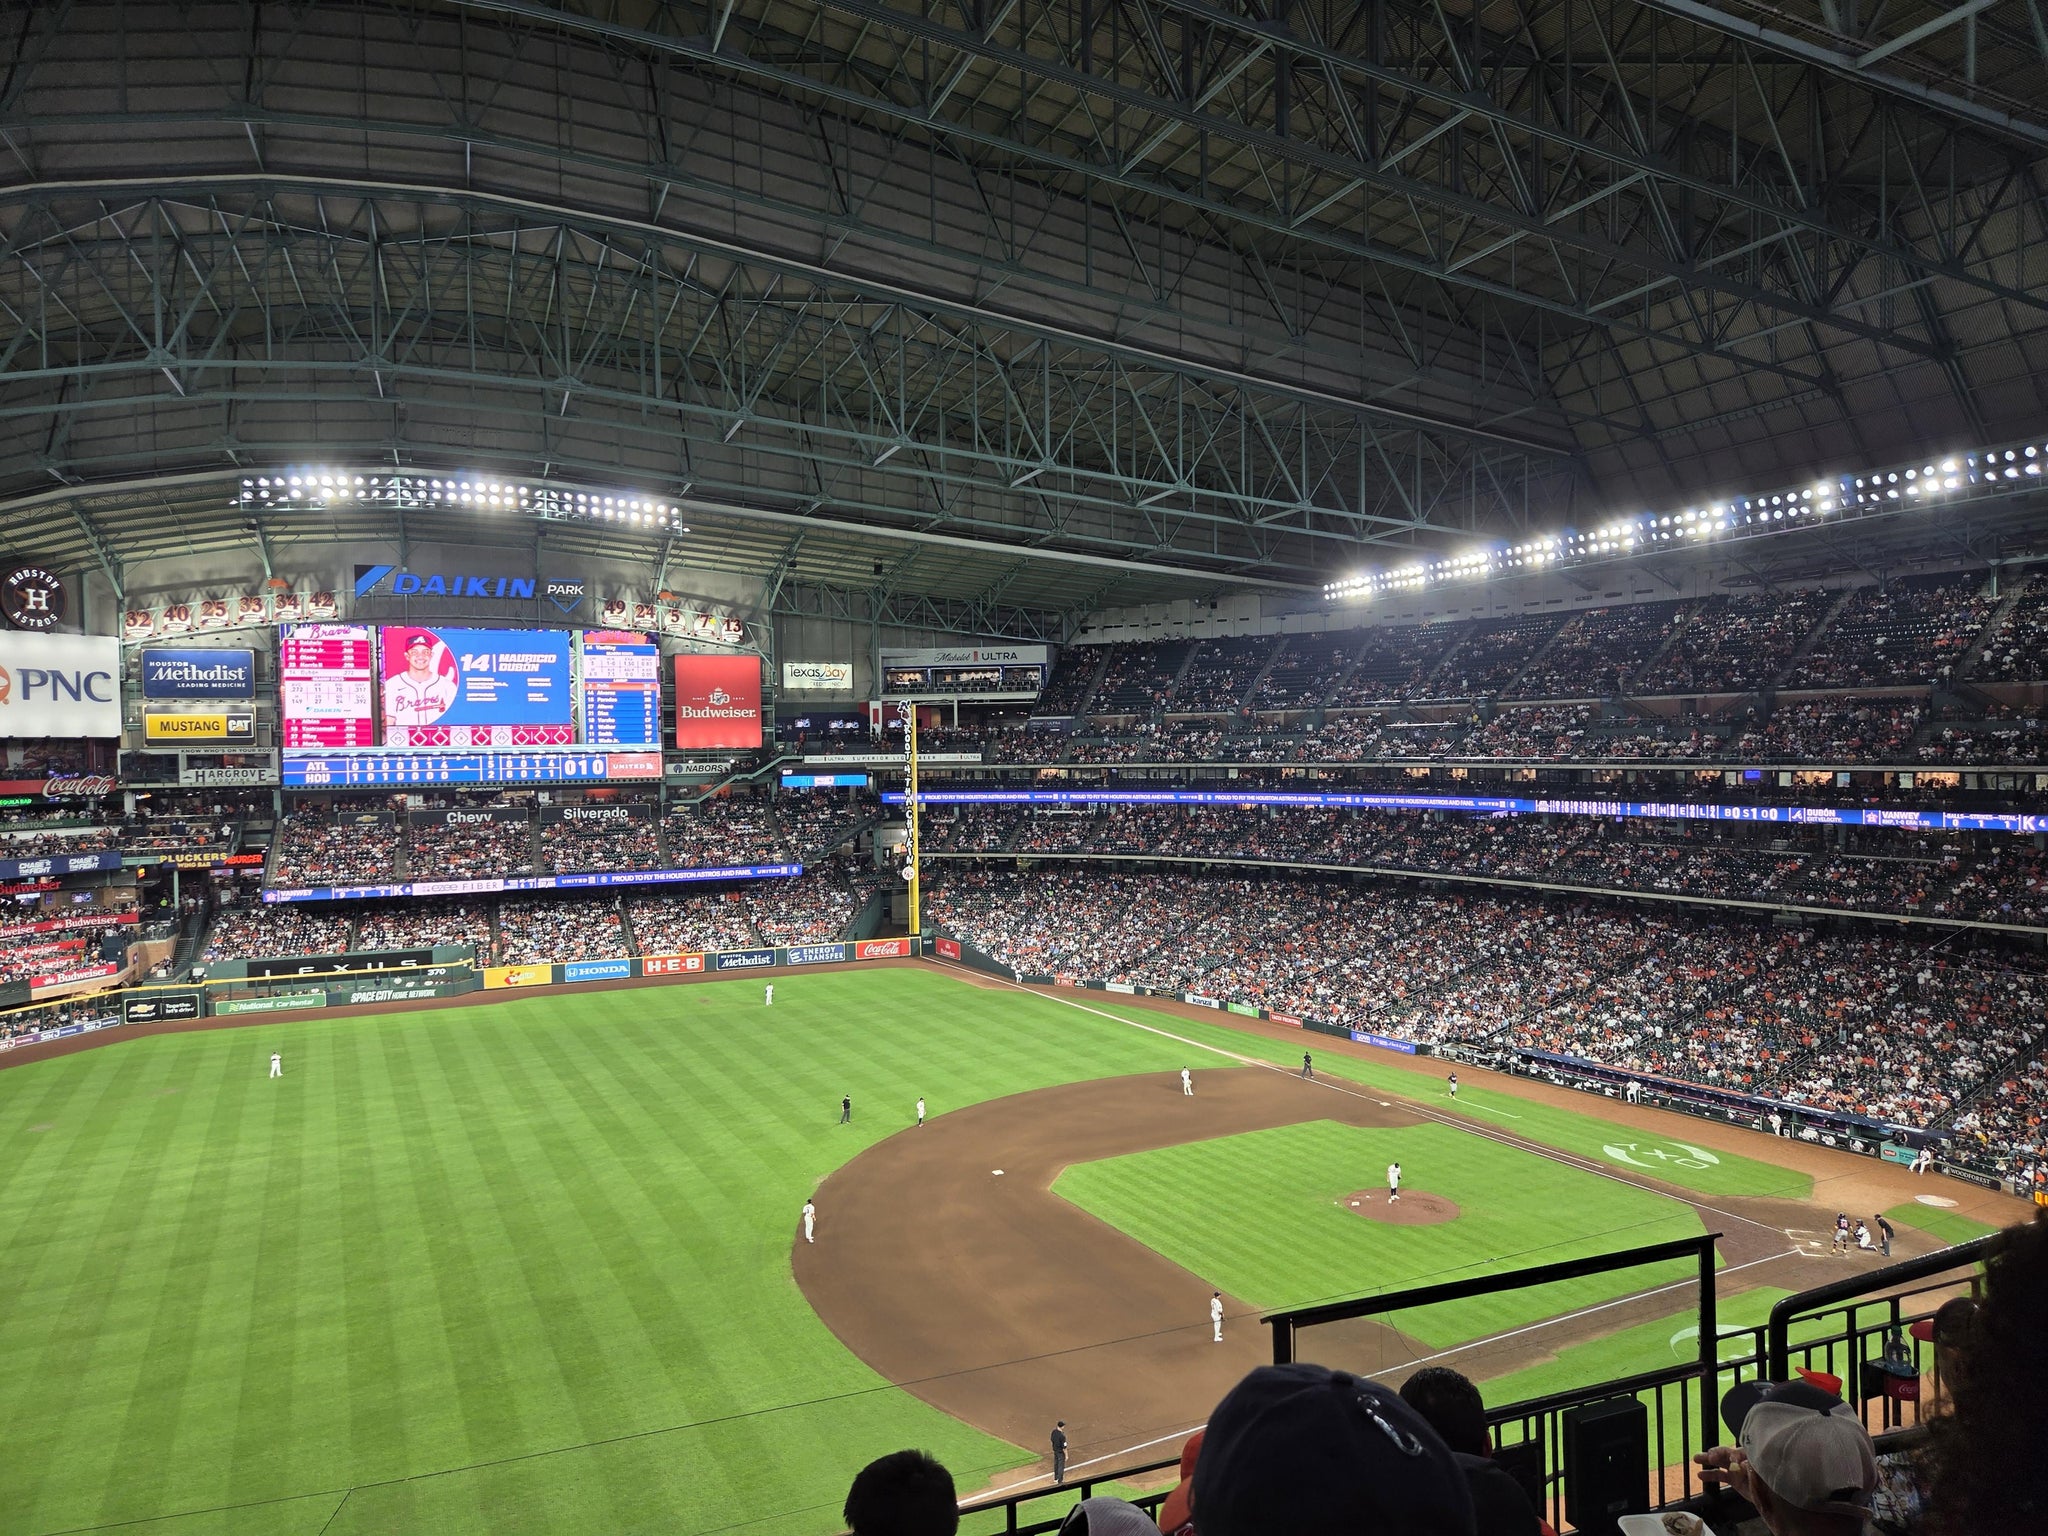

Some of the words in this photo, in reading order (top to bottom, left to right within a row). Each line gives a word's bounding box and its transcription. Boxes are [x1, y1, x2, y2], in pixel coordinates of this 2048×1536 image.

[8, 569, 60, 590] HOUSTON
[392, 573, 536, 598] DAIKIN
[547, 584, 584, 595] PARK
[24, 588, 49, 611] H
[239, 596, 264, 613] 33
[275, 594, 300, 609] 34
[310, 592, 334, 607] 42
[163, 604, 190, 622] 40
[201, 600, 227, 618] 25
[604, 600, 626, 614] 49
[635, 604, 656, 619] 24
[12, 611, 58, 627] ASTROS
[126, 610, 152, 628] 32
[670, 609, 680, 623] 5
[700, 614, 710, 628] 7
[724, 619, 742, 632] 13
[460, 653, 490, 672] 14
[498, 653, 557, 663] MAURICIO
[934, 653, 971, 662] Michelob
[981, 652, 1018, 661] ULTRA
[150, 664, 246, 681] Methodist
[788, 665, 820, 678] Texas
[825, 665, 847, 681] Bay
[16, 668, 112, 703] PNC
[160, 720, 220, 732] MUSTANG
[228, 719, 251, 732] CAT
[903, 724, 912, 761] ROOT
[306, 761, 330, 771] ATL
[352, 762, 359, 770] 0
[367, 762, 374, 770] 0
[382, 762, 389, 770] 0
[397, 762, 404, 770] 0
[426, 761, 432, 769] 1
[440, 761, 448, 769] 4
[488, 760, 495, 768] 5
[506, 760, 513, 768] 8
[520, 760, 527, 768] 0
[534, 760, 540, 768] 1
[564, 759, 576, 775] 0
[578, 759, 588, 775] 1
[592, 759, 604, 775] 0
[686, 764, 723, 773] NABORS
[195, 770, 266, 783] HARGROVE
[305, 773, 331, 783] HOU
[42, 775, 116, 798] Coca-Cola
[563, 807, 628, 820] Silverado
[1641, 806, 1647, 814] R
[1660, 806, 1666, 814] H
[1680, 807, 1686, 815] E
[1700, 808, 1706, 816] L
[1724, 808, 1732, 817] B
[1732, 807, 1740, 819] 0
[1742, 809, 1749, 818] S
[1750, 808, 1757, 819] 1
[1769, 808, 1778, 820] 0
[1882, 811, 1920, 820] VANWEY
[5, 822, 44, 830] HORNITOS
[1952, 819, 1959, 827] 0
[2023, 815, 2036, 831] K
[2038, 819, 2046, 827] 4
[906, 809, 914, 865] CHIKIN
[69, 857, 96, 865] CHASE
[159, 852, 228, 863] PLUCKERS
[19, 861, 45, 870] CHASE
[29, 866, 52, 875] FIGHT
[78, 862, 100, 871] FIGHT
[666, 872, 696, 880] HOUSTON
[0, 880, 62, 894] Budweiser
[281, 889, 313, 897] VANWEY
[394, 885, 404, 895] K
[431, 884, 458, 892] ezee
[462, 881, 498, 891] FIBER
[64, 916, 118, 928] Budweiser
[803, 945, 836, 954] ENERGY
[864, 942, 900, 956] Coca-Cola
[721, 954, 771, 968] Methodist
[804, 952, 844, 962] TRANSFER
[57, 966, 108, 983] Budweiser
[427, 968, 446, 976] 370
[579, 965, 628, 975] HONDA
[350, 991, 376, 1004] SPACE
[376, 990, 393, 1002] CITY
[392, 991, 408, 1000] HOME
[408, 989, 436, 998] NETWORK
[239, 1000, 274, 1010] National
[290, 998, 314, 1007] Rental
[1950, 1168, 1992, 1185] WOODFOREST
